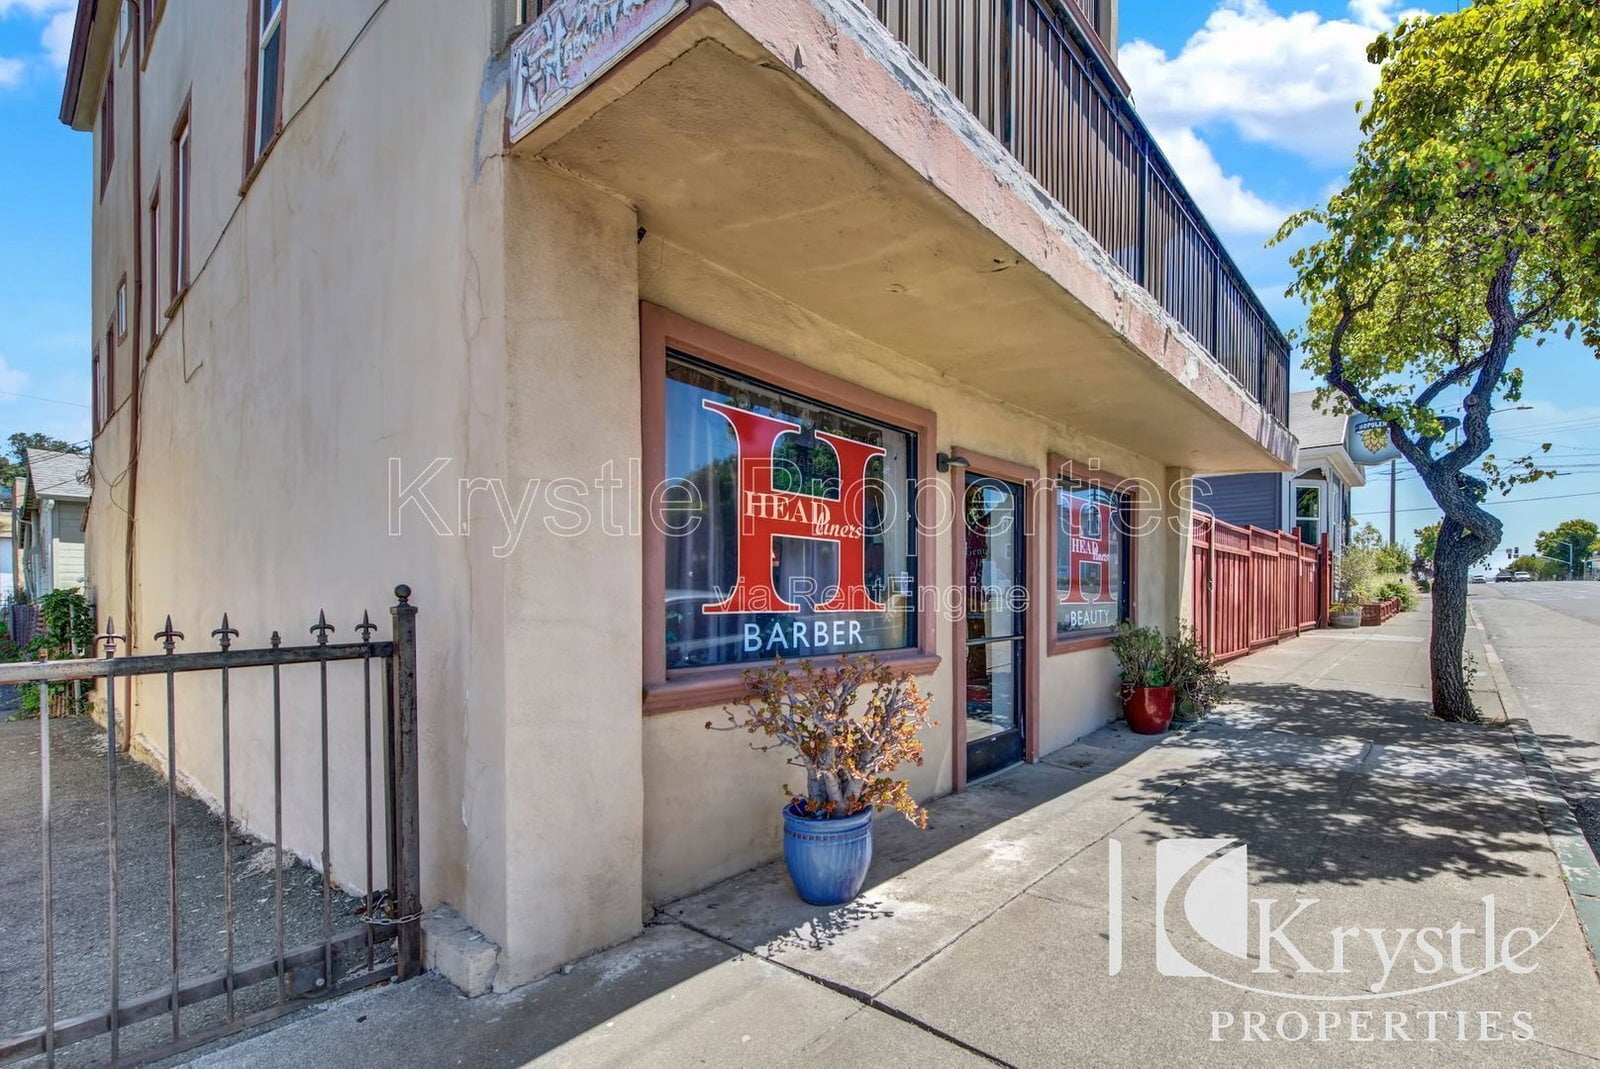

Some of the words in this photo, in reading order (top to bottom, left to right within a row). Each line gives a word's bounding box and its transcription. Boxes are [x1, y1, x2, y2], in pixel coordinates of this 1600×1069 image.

[743, 490, 832, 526] HEAD
[1071, 537, 1100, 556] HEAD
[1070, 608, 1111, 627] BEAUTY
[743, 619, 864, 653] BARBER
